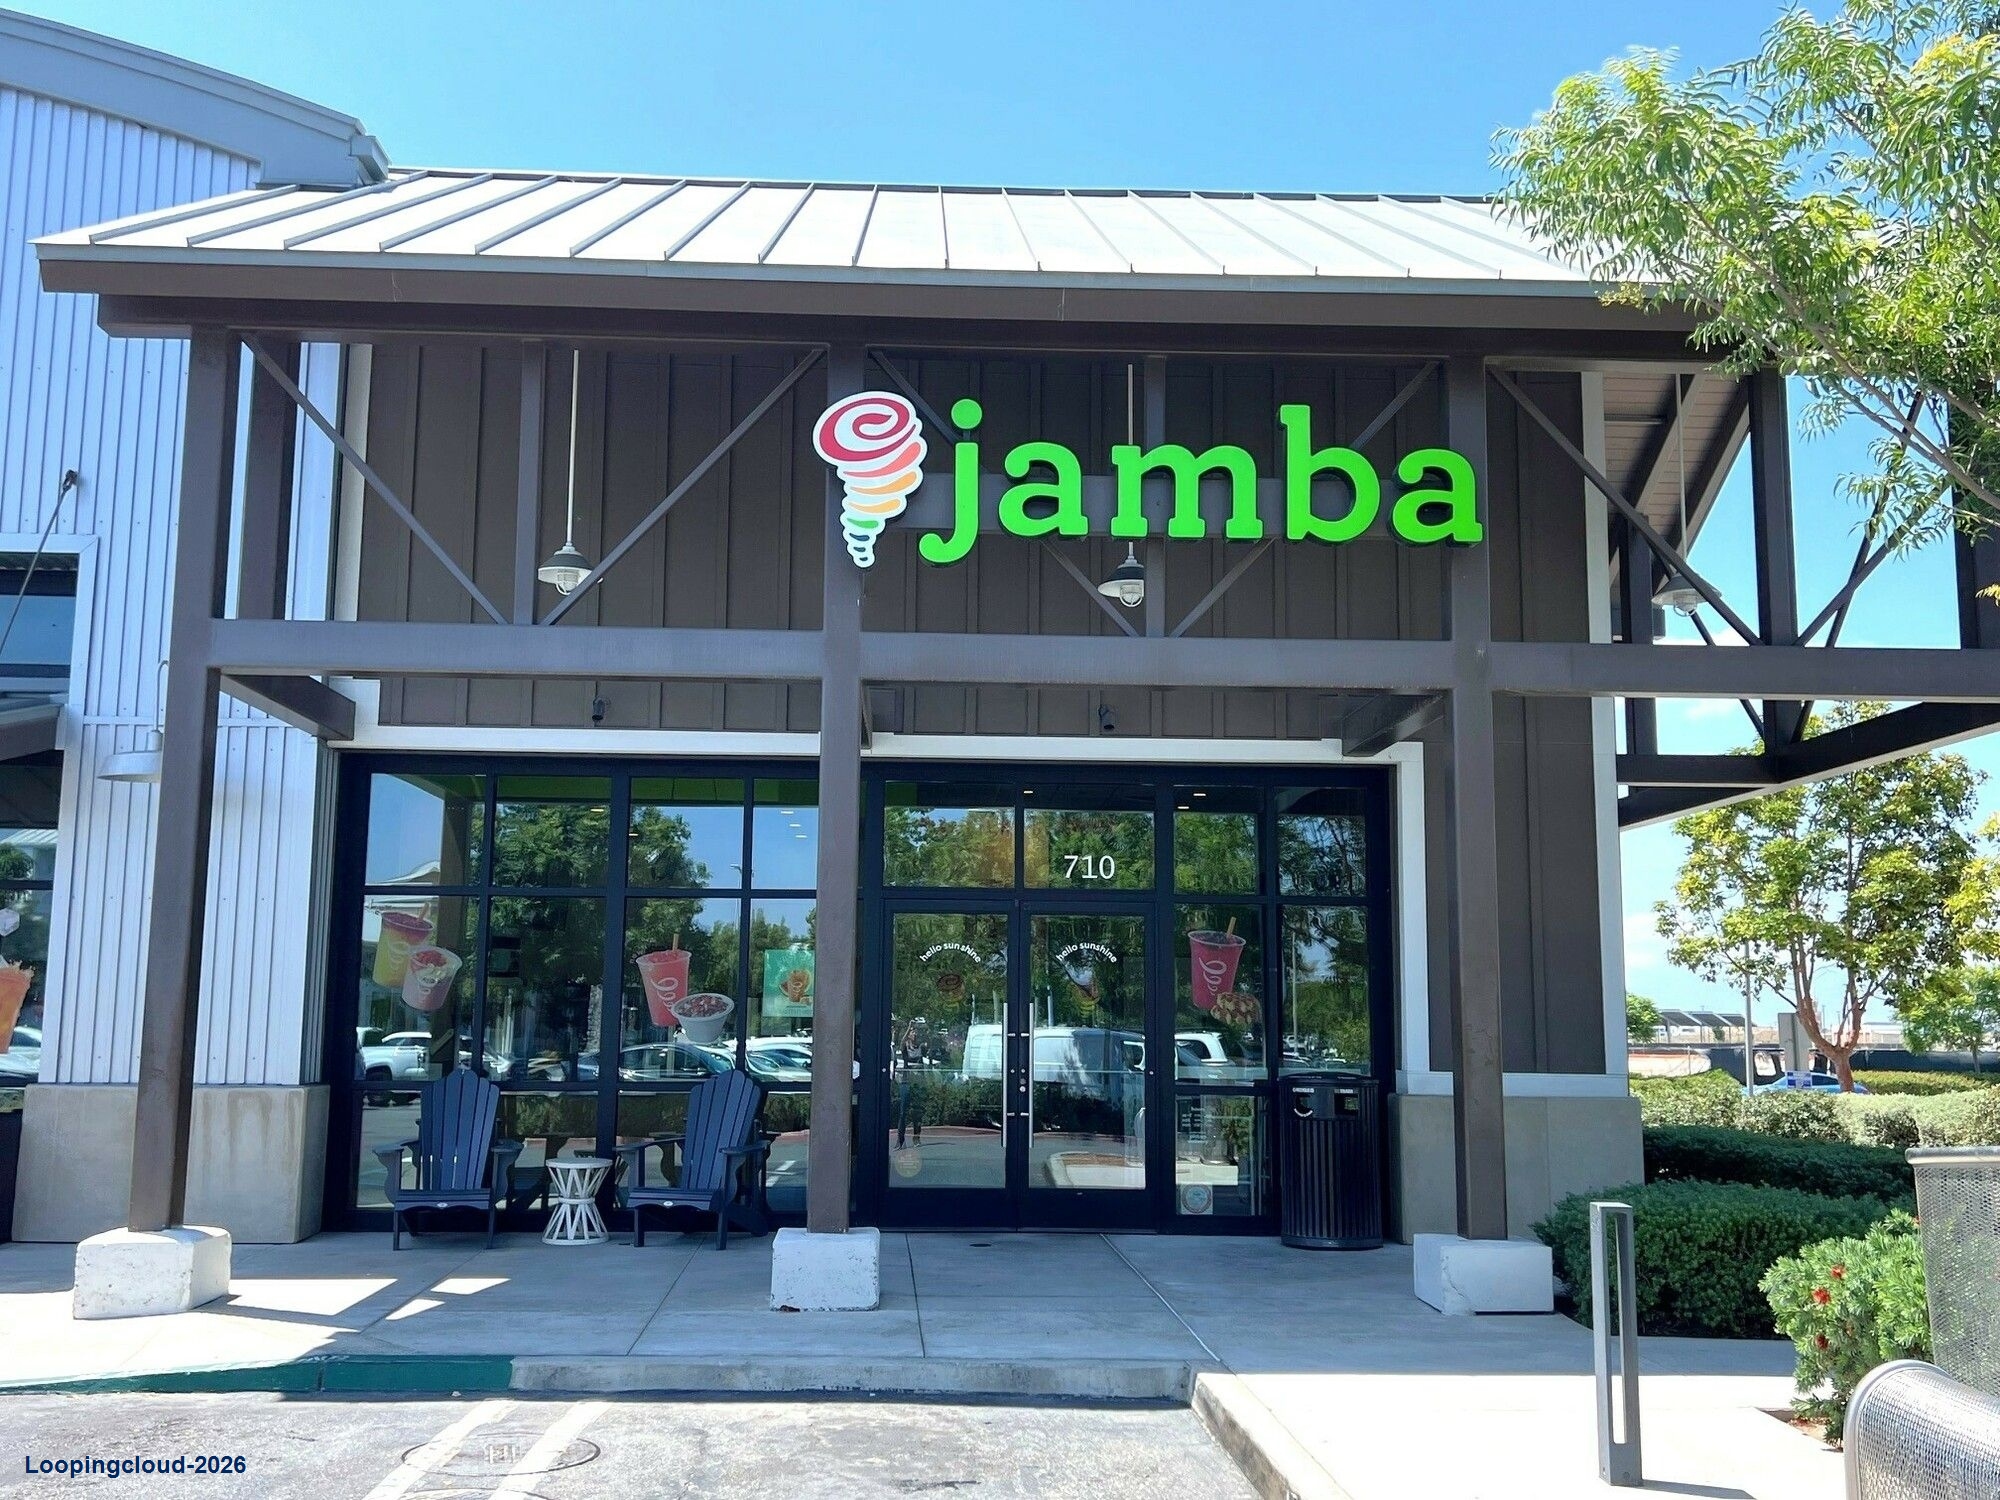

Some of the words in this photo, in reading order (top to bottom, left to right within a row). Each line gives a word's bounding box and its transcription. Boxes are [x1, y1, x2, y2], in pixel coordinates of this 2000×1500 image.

[919, 398, 1484, 566] jamba
[1063, 854, 1115, 879] 710
[919, 945, 942, 962] hello
[943, 943, 982, 964] sunshine
[1056, 943, 1078, 962] hello
[1079, 942, 1117, 963] sunshine
